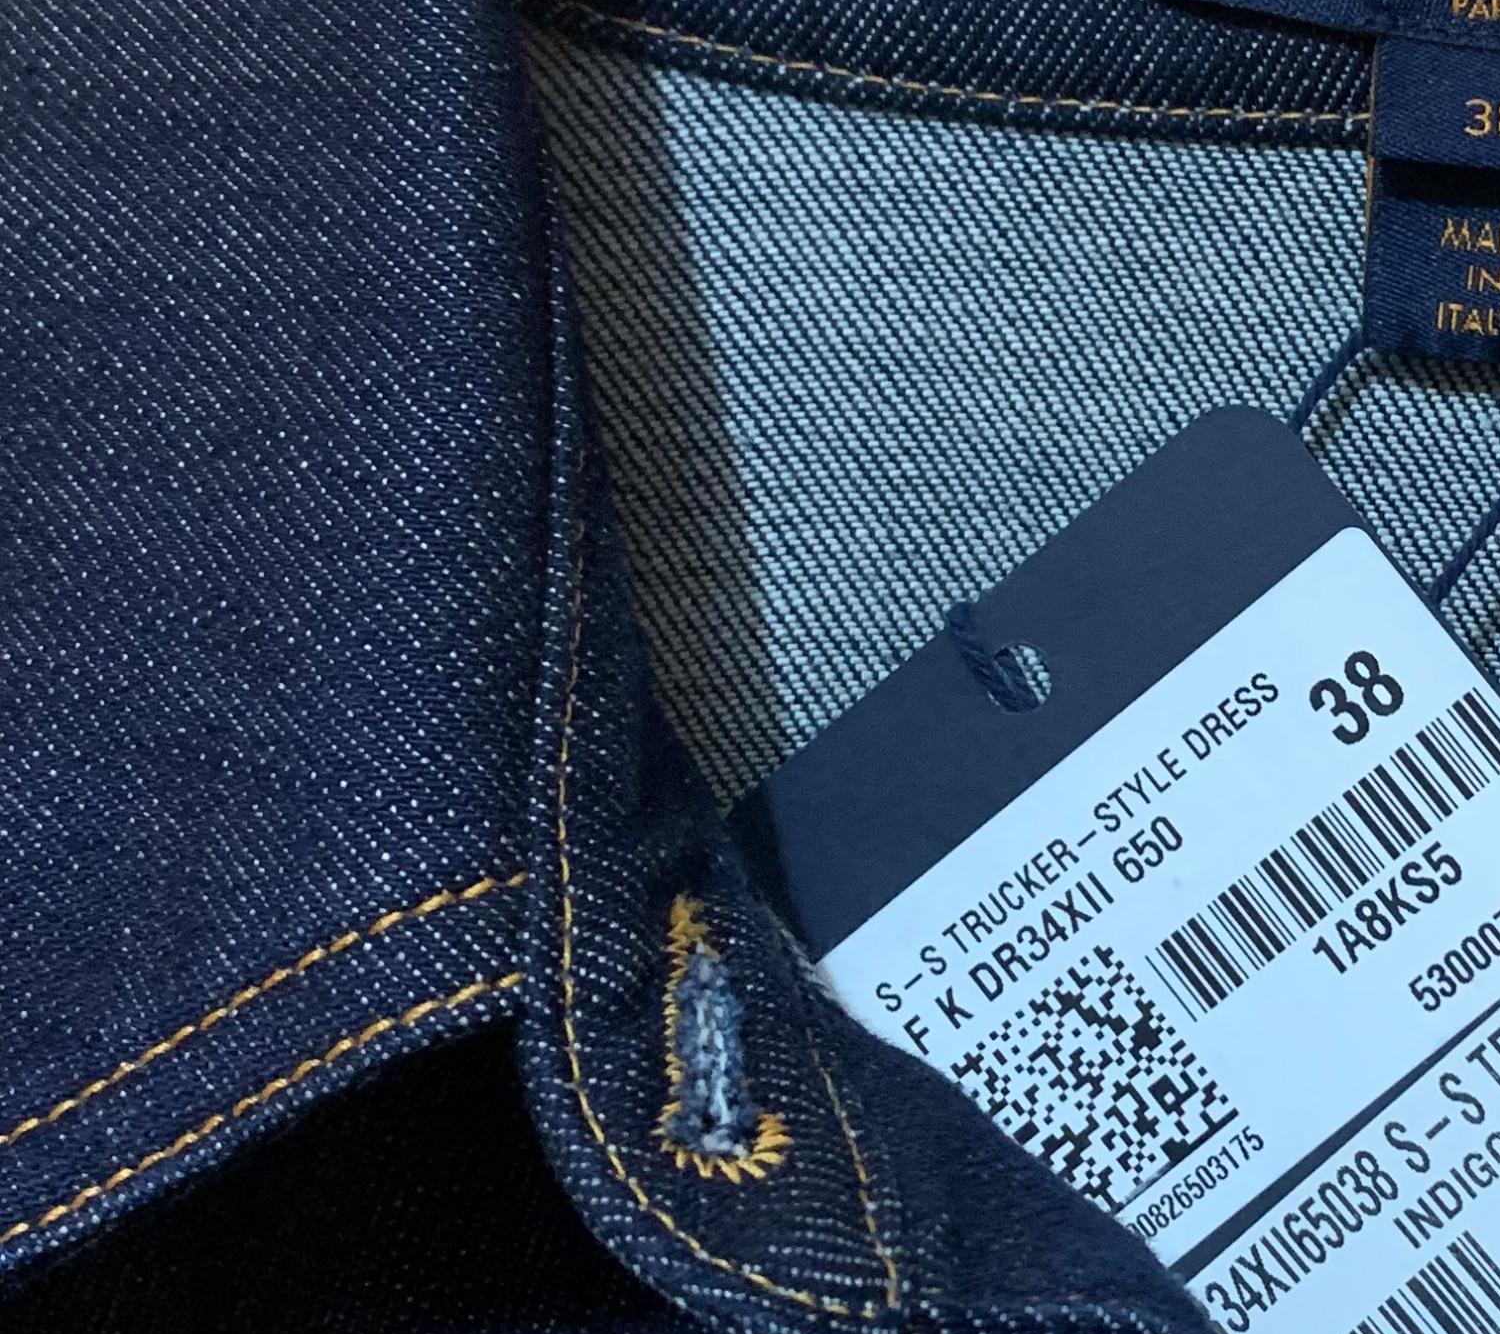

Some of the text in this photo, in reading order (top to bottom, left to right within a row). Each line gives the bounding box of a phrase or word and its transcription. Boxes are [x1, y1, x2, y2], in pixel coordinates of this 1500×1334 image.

[1310, 651, 1404, 745] 38
[942, 749, 1187, 953] TRUCKER-STYLE
[1182, 673, 1278, 760] DRESS
[903, 817, 1182, 1055] F K DR34XII 650
[1313, 842, 1462, 974] 1A8KS5
